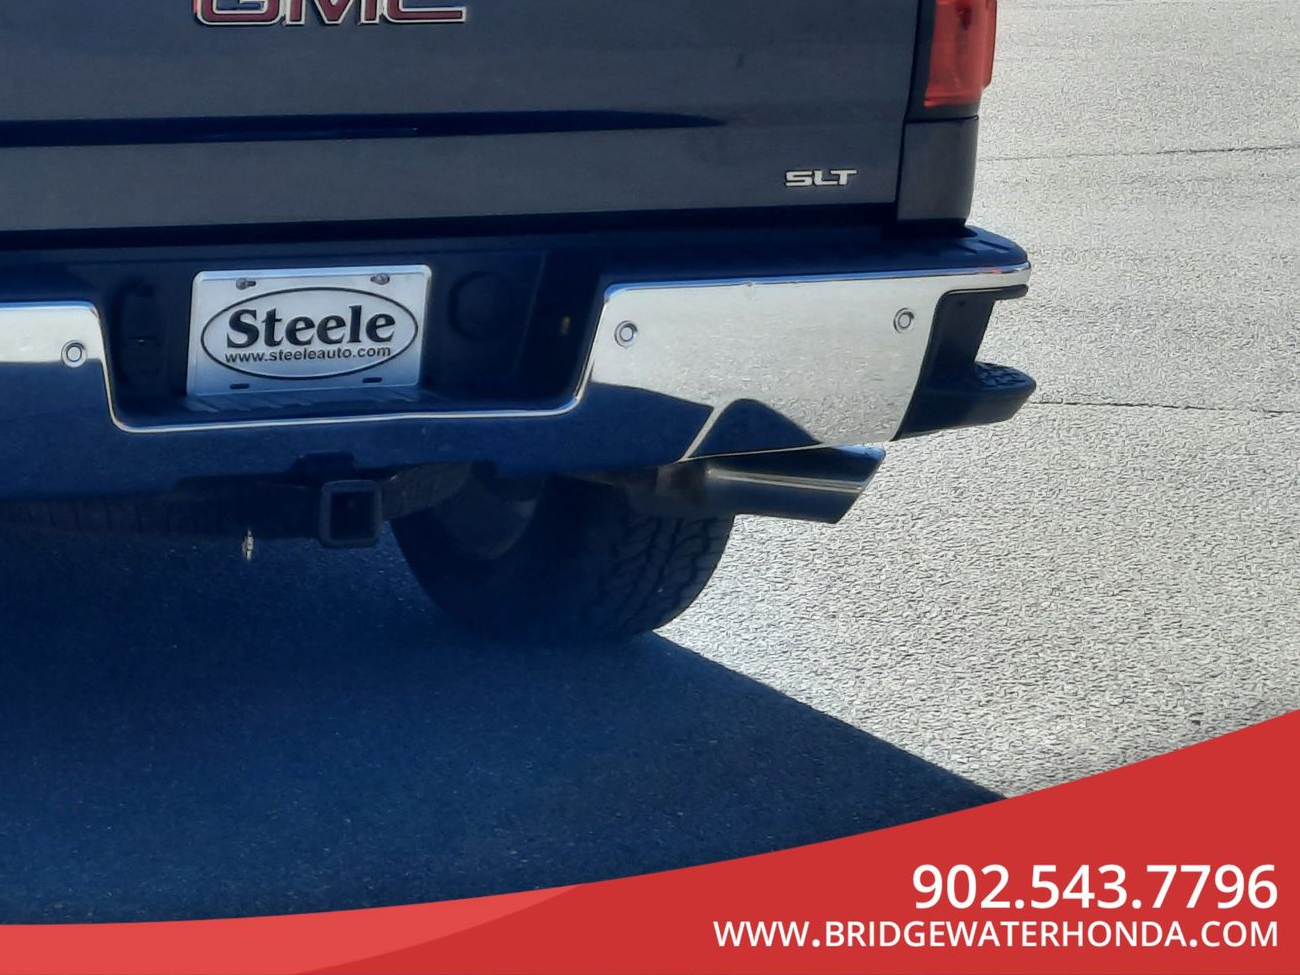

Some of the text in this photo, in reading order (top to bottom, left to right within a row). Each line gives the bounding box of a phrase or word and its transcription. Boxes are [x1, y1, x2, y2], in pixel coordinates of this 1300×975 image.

[784, 169, 858, 187] SLT
[225, 304, 397, 349] Steele
[224, 345, 392, 364] www.steeleauto.com
